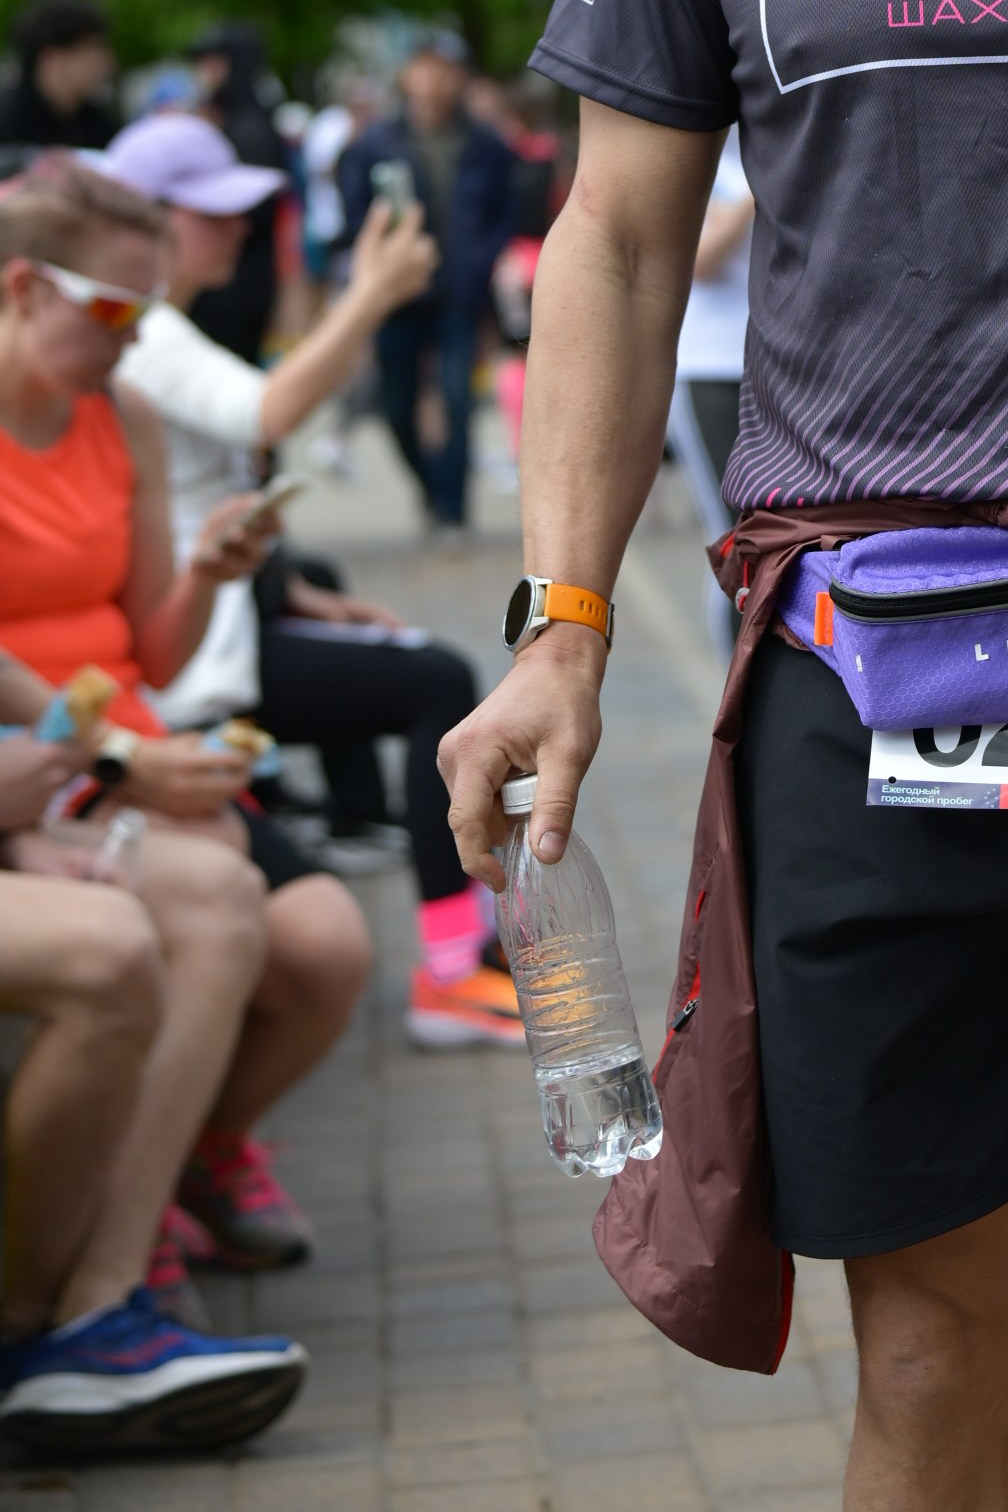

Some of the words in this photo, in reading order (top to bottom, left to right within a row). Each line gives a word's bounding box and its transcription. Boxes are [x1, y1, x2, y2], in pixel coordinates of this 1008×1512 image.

[881, 784, 941, 796] Ежегодный
[880, 794, 935, 805] городской
[936, 796, 974, 807] пробег
